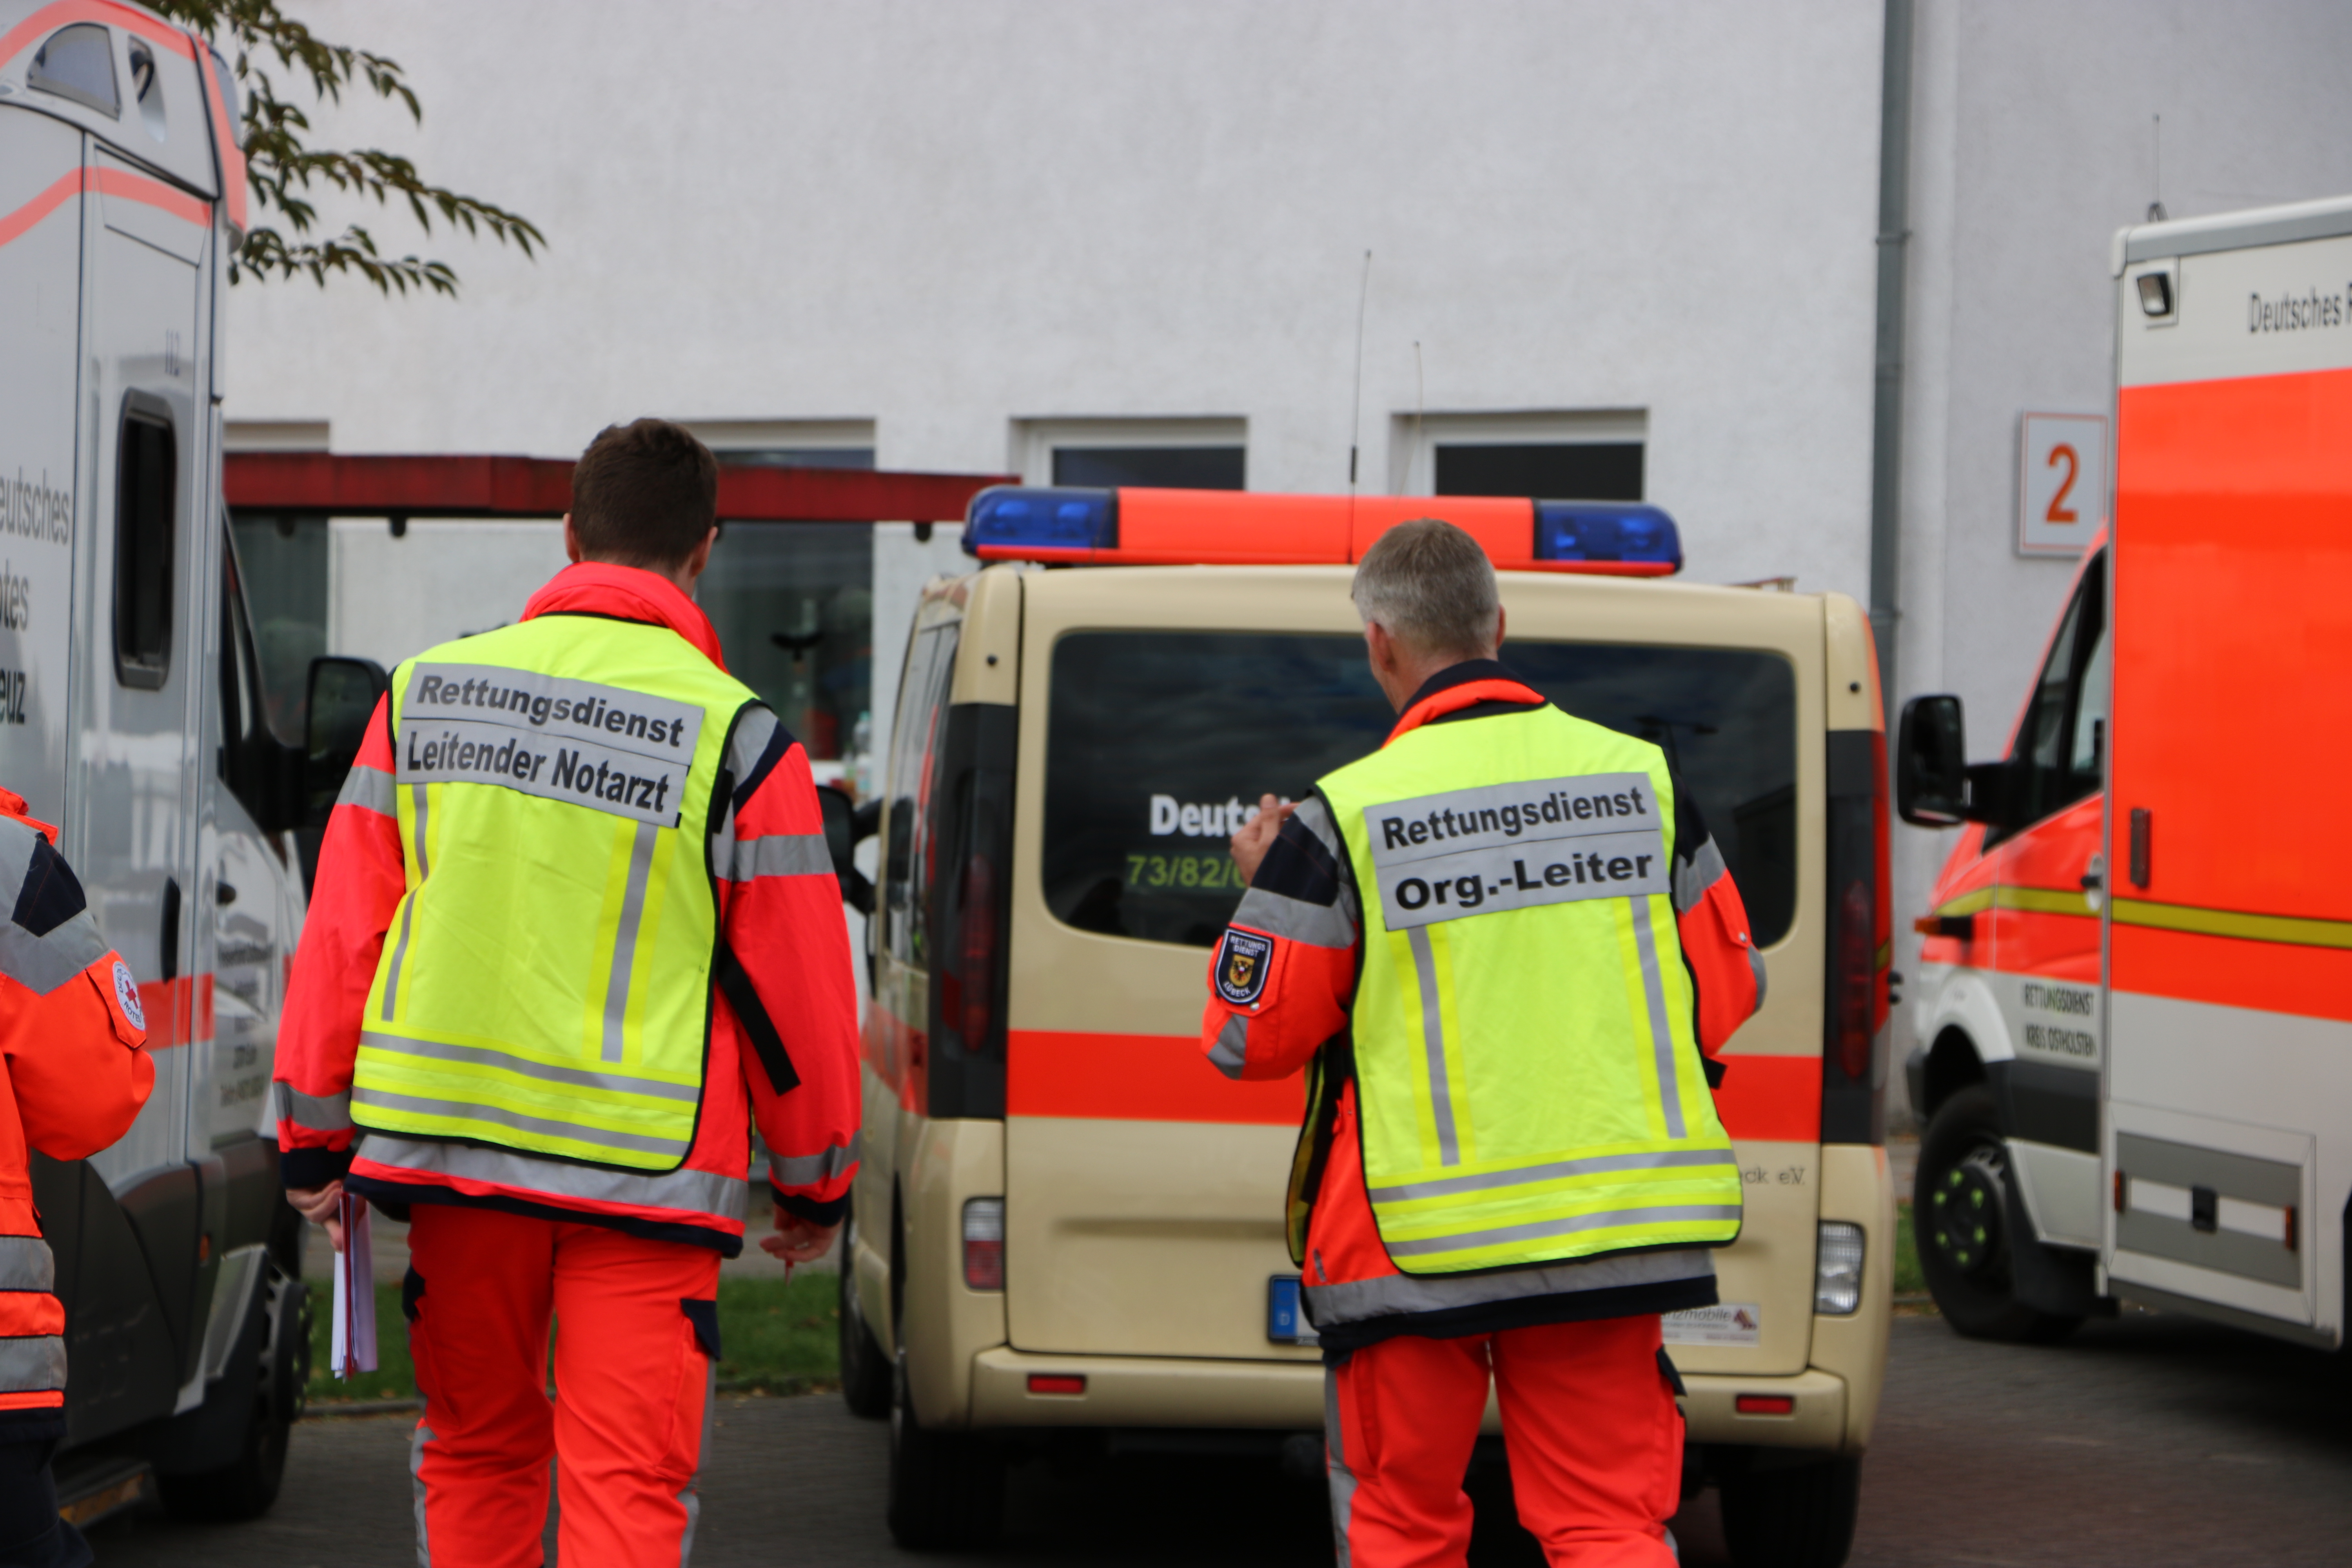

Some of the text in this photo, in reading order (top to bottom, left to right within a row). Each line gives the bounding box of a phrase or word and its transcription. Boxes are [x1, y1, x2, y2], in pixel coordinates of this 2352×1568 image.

[2250, 285, 2342, 333] Deutsches
[2046, 442, 2079, 523] 2
[0, 558, 29, 631] tes
[417, 675, 684, 748] Rettungsdienst
[407, 731, 669, 813] Leitender Notarzt
[1382, 787, 1647, 850] Rettungsdienst
[1396, 852, 1653, 911] Org.-Leiter
[1230, 936, 1266, 951] RETTUNGS
[1233, 945, 1259, 957] DIENST
[1223, 982, 1251, 997] LÜBECK
[2025, 983, 2094, 1016] RETTUNGSDIENST
[2026, 1024, 2097, 1058] KREIS OSTHOLSTEIN
[1740, 1166, 1769, 1185] ck
